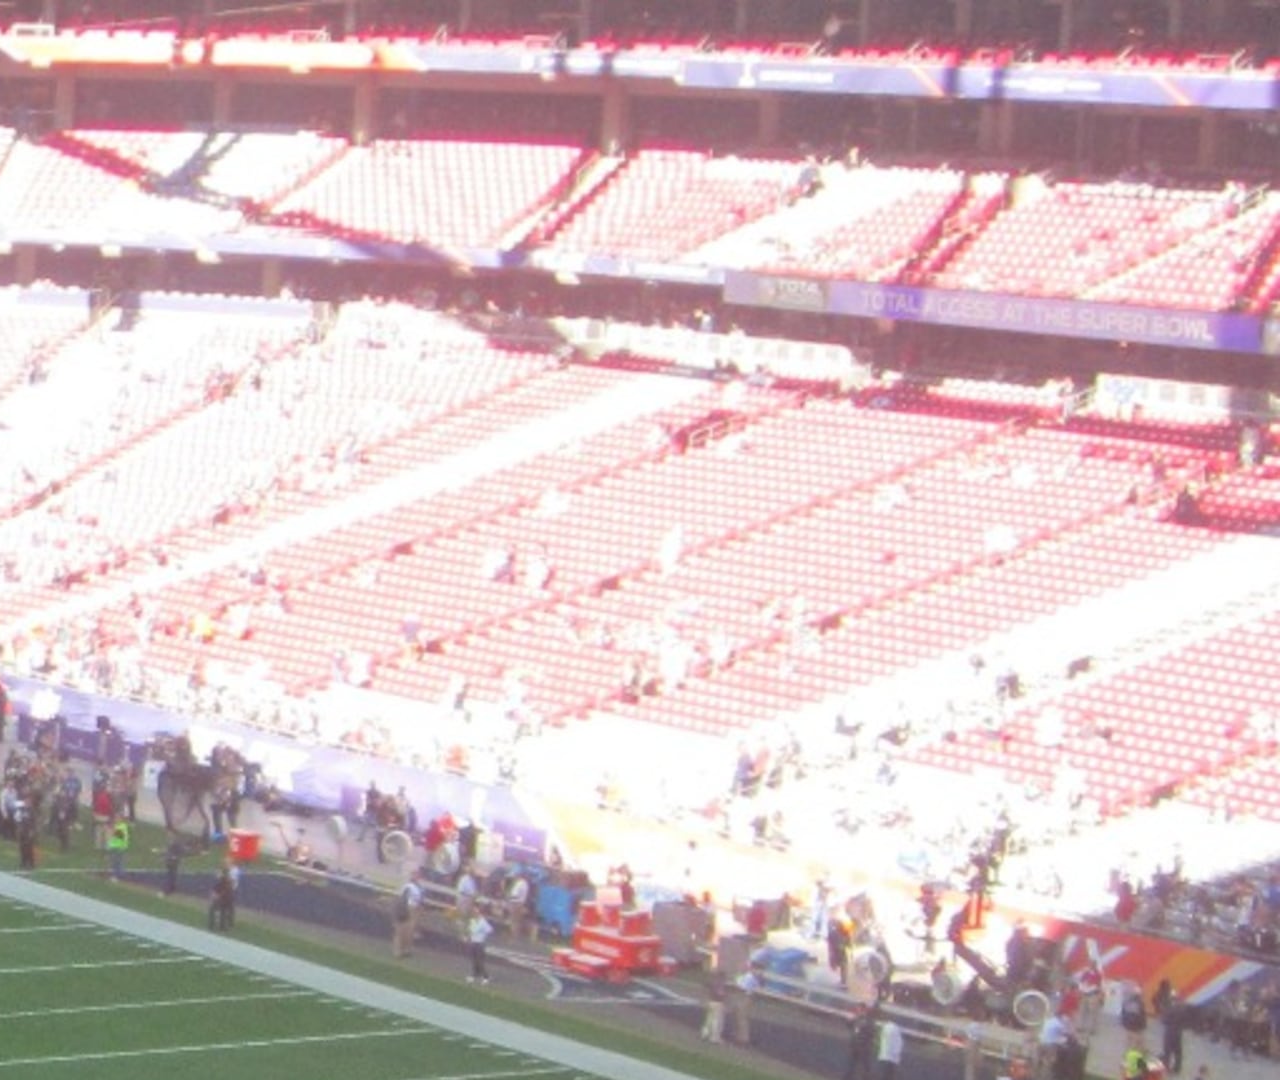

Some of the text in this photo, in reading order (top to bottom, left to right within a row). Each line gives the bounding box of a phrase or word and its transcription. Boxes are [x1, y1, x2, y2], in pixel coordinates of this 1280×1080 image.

[860, 290, 1215, 341] TOTAL ACCESS AT THE SUPER BOWL
